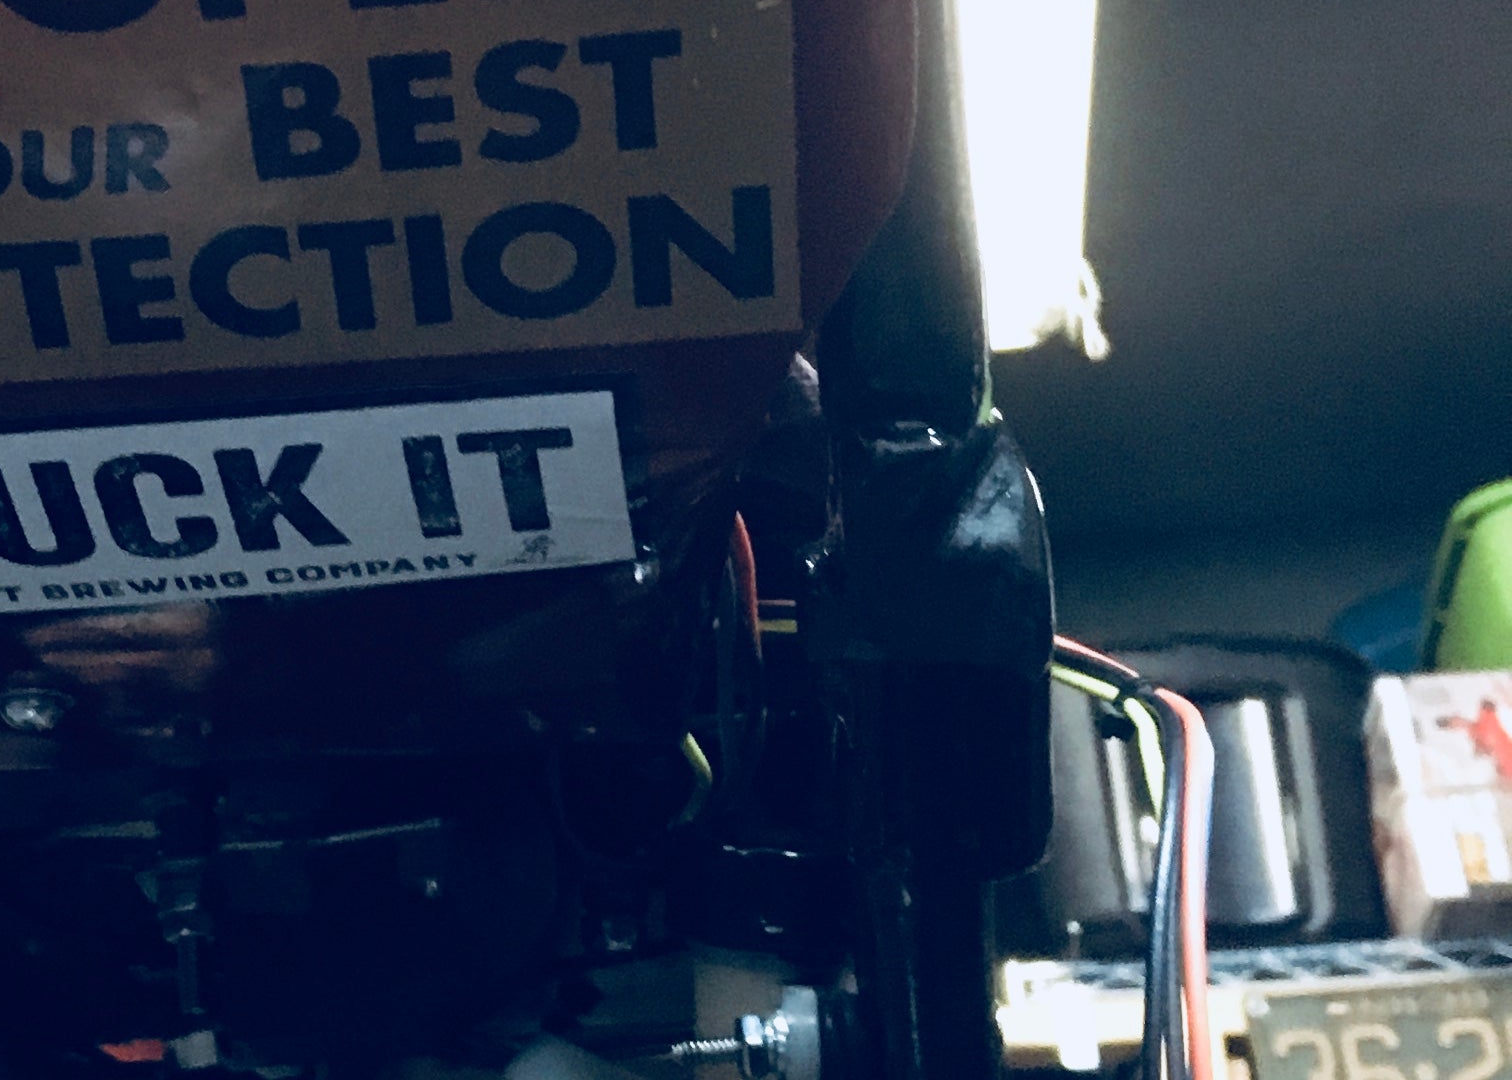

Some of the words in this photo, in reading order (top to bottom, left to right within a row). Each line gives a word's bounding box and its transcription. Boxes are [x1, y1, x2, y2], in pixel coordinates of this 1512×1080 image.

[240, 28, 682, 182] BEST
[402, 427, 574, 539] IT
[41, 569, 249, 601] BREWING
[265, 552, 478, 585] COMPANY
